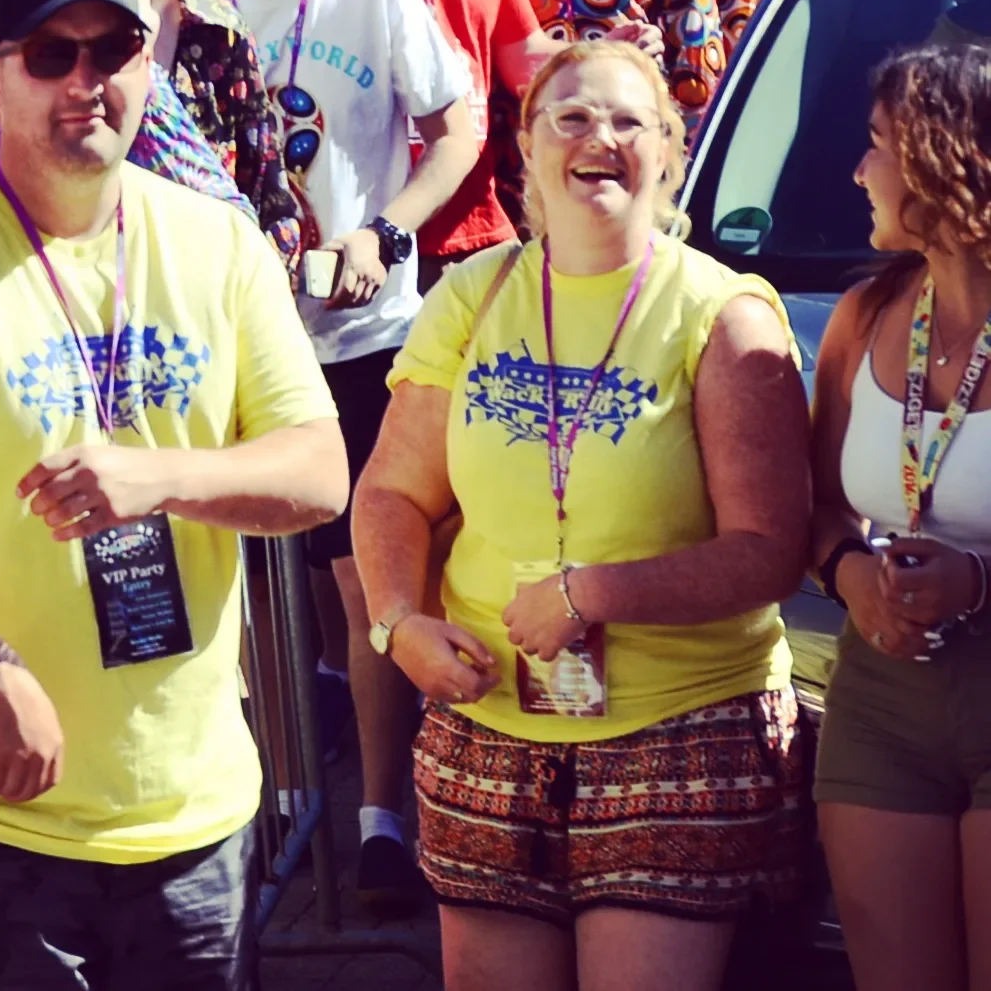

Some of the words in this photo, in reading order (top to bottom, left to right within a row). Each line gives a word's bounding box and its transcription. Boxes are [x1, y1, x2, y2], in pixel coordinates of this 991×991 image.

[487, 375, 551, 406] Wack
[102, 569, 128, 585] VIP
[130, 564, 166, 580] Party
